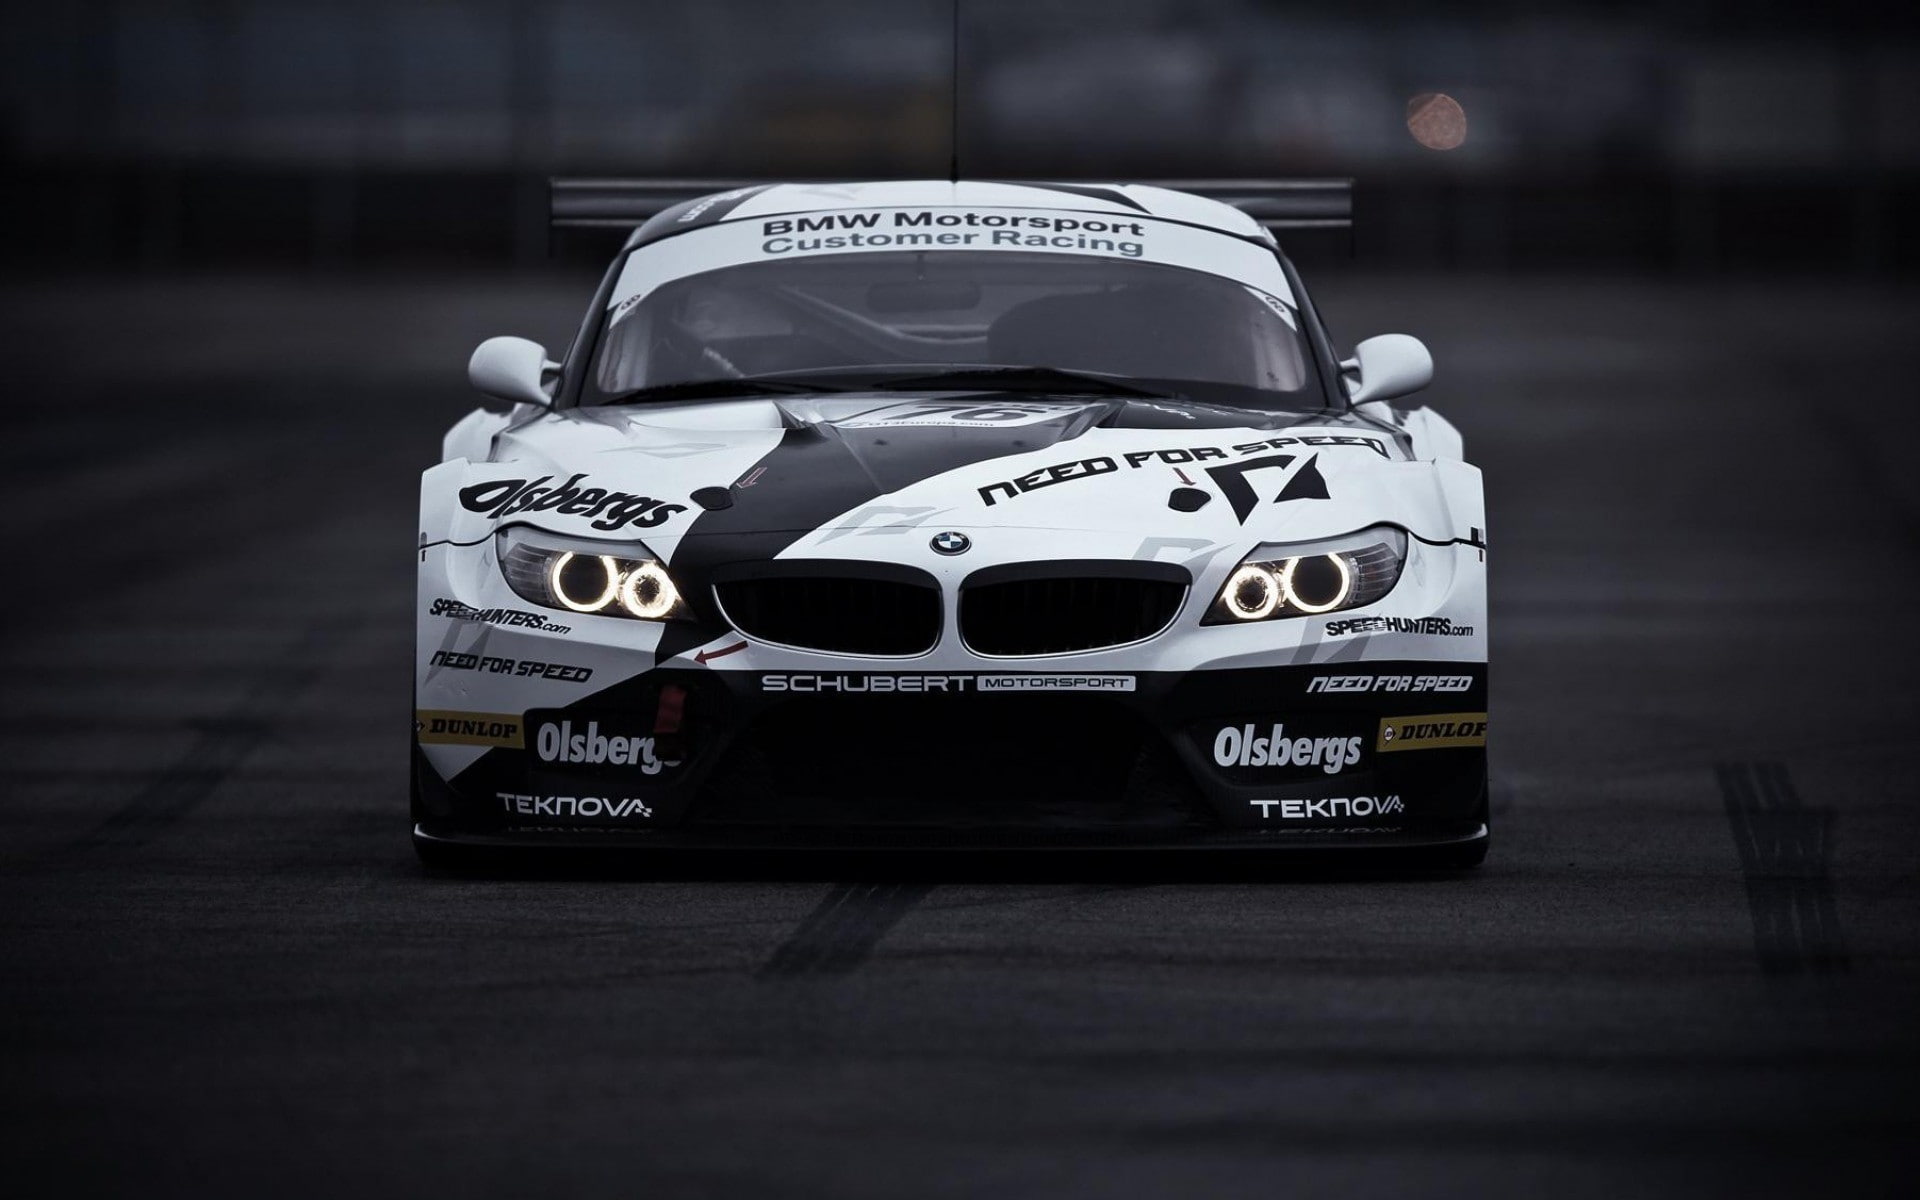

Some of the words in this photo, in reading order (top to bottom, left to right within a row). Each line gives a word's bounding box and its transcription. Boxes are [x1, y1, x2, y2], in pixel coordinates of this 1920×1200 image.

[763, 212, 880, 236] BMW
[894, 211, 1145, 237] Motorsport
[762, 230, 979, 254] Customer
[992, 231, 1145, 258] Racing
[882, 405, 1047, 421] 76
[977, 456, 1119, 507] NEED
[1123, 446, 1228, 468] FOR
[1232, 436, 1391, 460] SPEED
[459, 473, 688, 531] Olsbergs
[429, 651, 479, 671] NEED
[478, 656, 514, 675] FOR
[517, 660, 593, 683] SPEED
[761, 674, 974, 692] SCHUBERT
[984, 677, 1131, 689] MOTORSPORT
[1305, 675, 1374, 693] NEED
[1371, 675, 1413, 692] FOR
[1413, 675, 1474, 692] SPEED
[429, 718, 518, 739] DUNLOP
[1398, 721, 1488, 740] DUNLOP
[536, 720, 682, 775] Olsberg
[1213, 723, 1362, 775] Olsbergs
[495, 791, 653, 818] TEKNOVA
[1249, 795, 1406, 819] TEKNOVA
